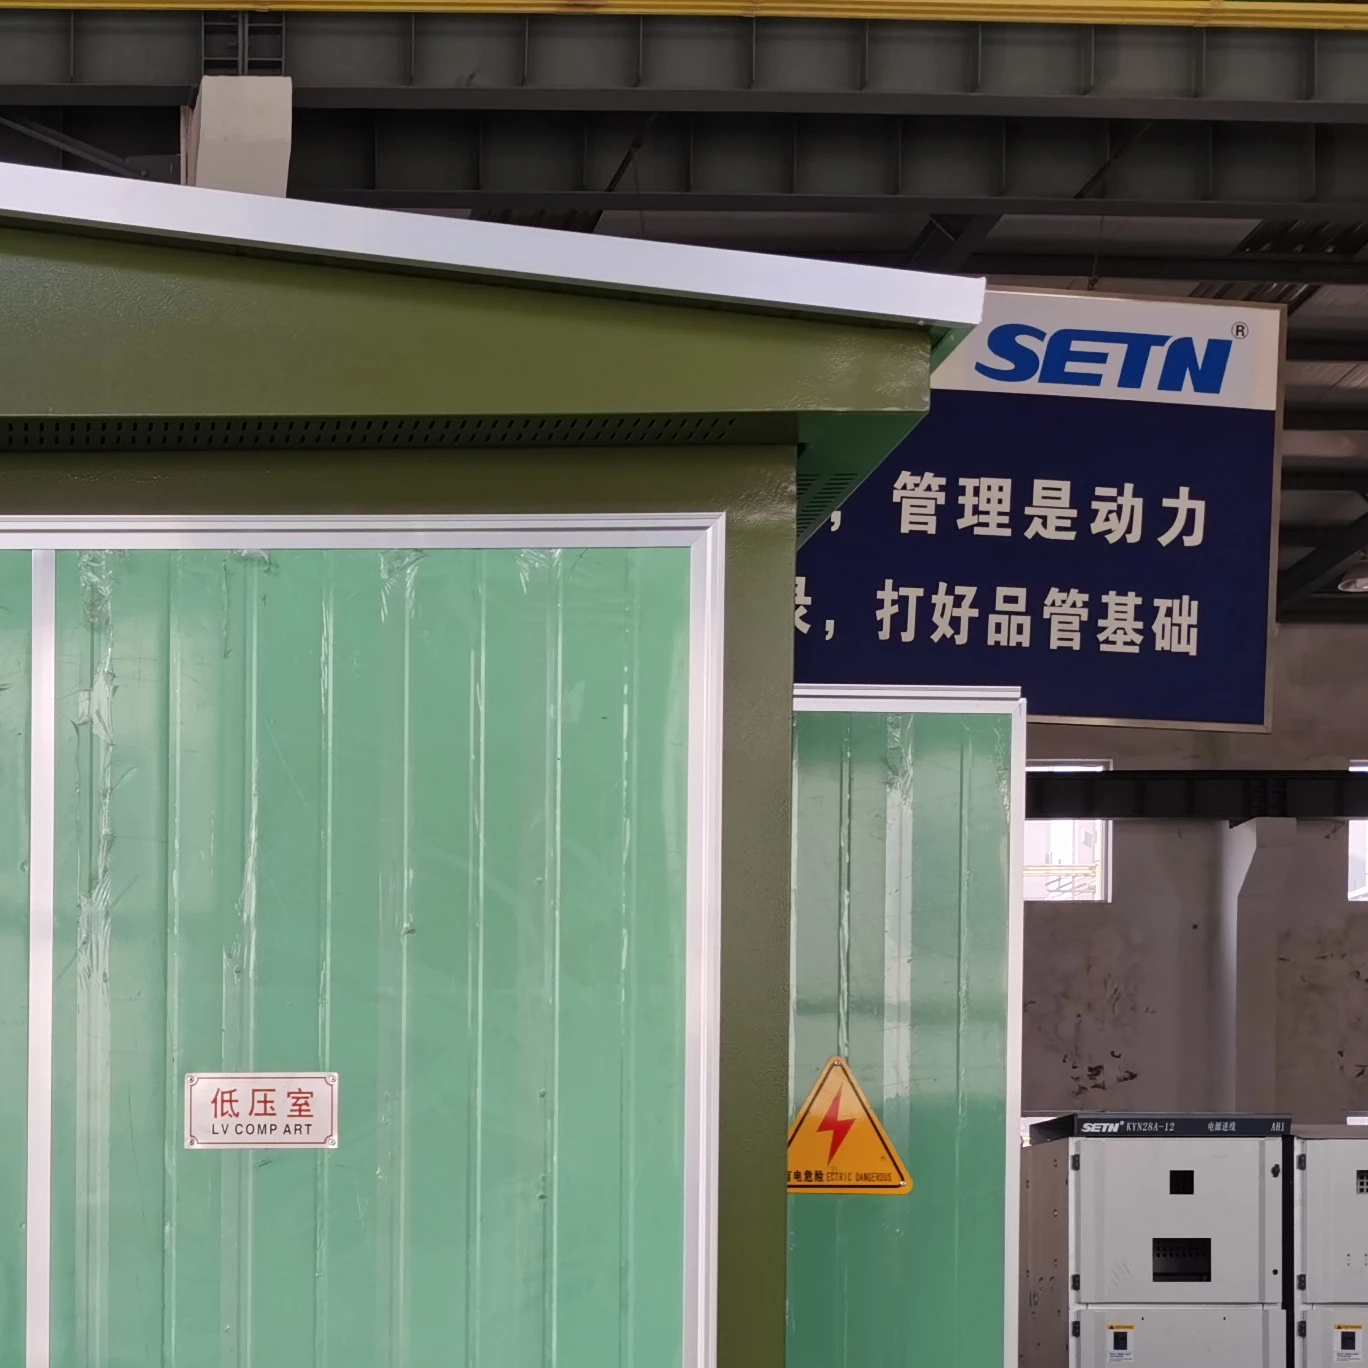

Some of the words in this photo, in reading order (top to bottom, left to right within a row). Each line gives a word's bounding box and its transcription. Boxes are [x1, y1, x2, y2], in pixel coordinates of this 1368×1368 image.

[974, 323, 1233, 394] SETN
[211, 1088, 314, 1118] 低压室
[212, 1123, 230, 1135] LV
[1081, 1122, 1120, 1133] SETN
[1126, 1122, 1175, 1132] KYN28A-12
[1207, 1121, 1236, 1132] 电源进线
[1270, 1122, 1285, 1132] AH1
